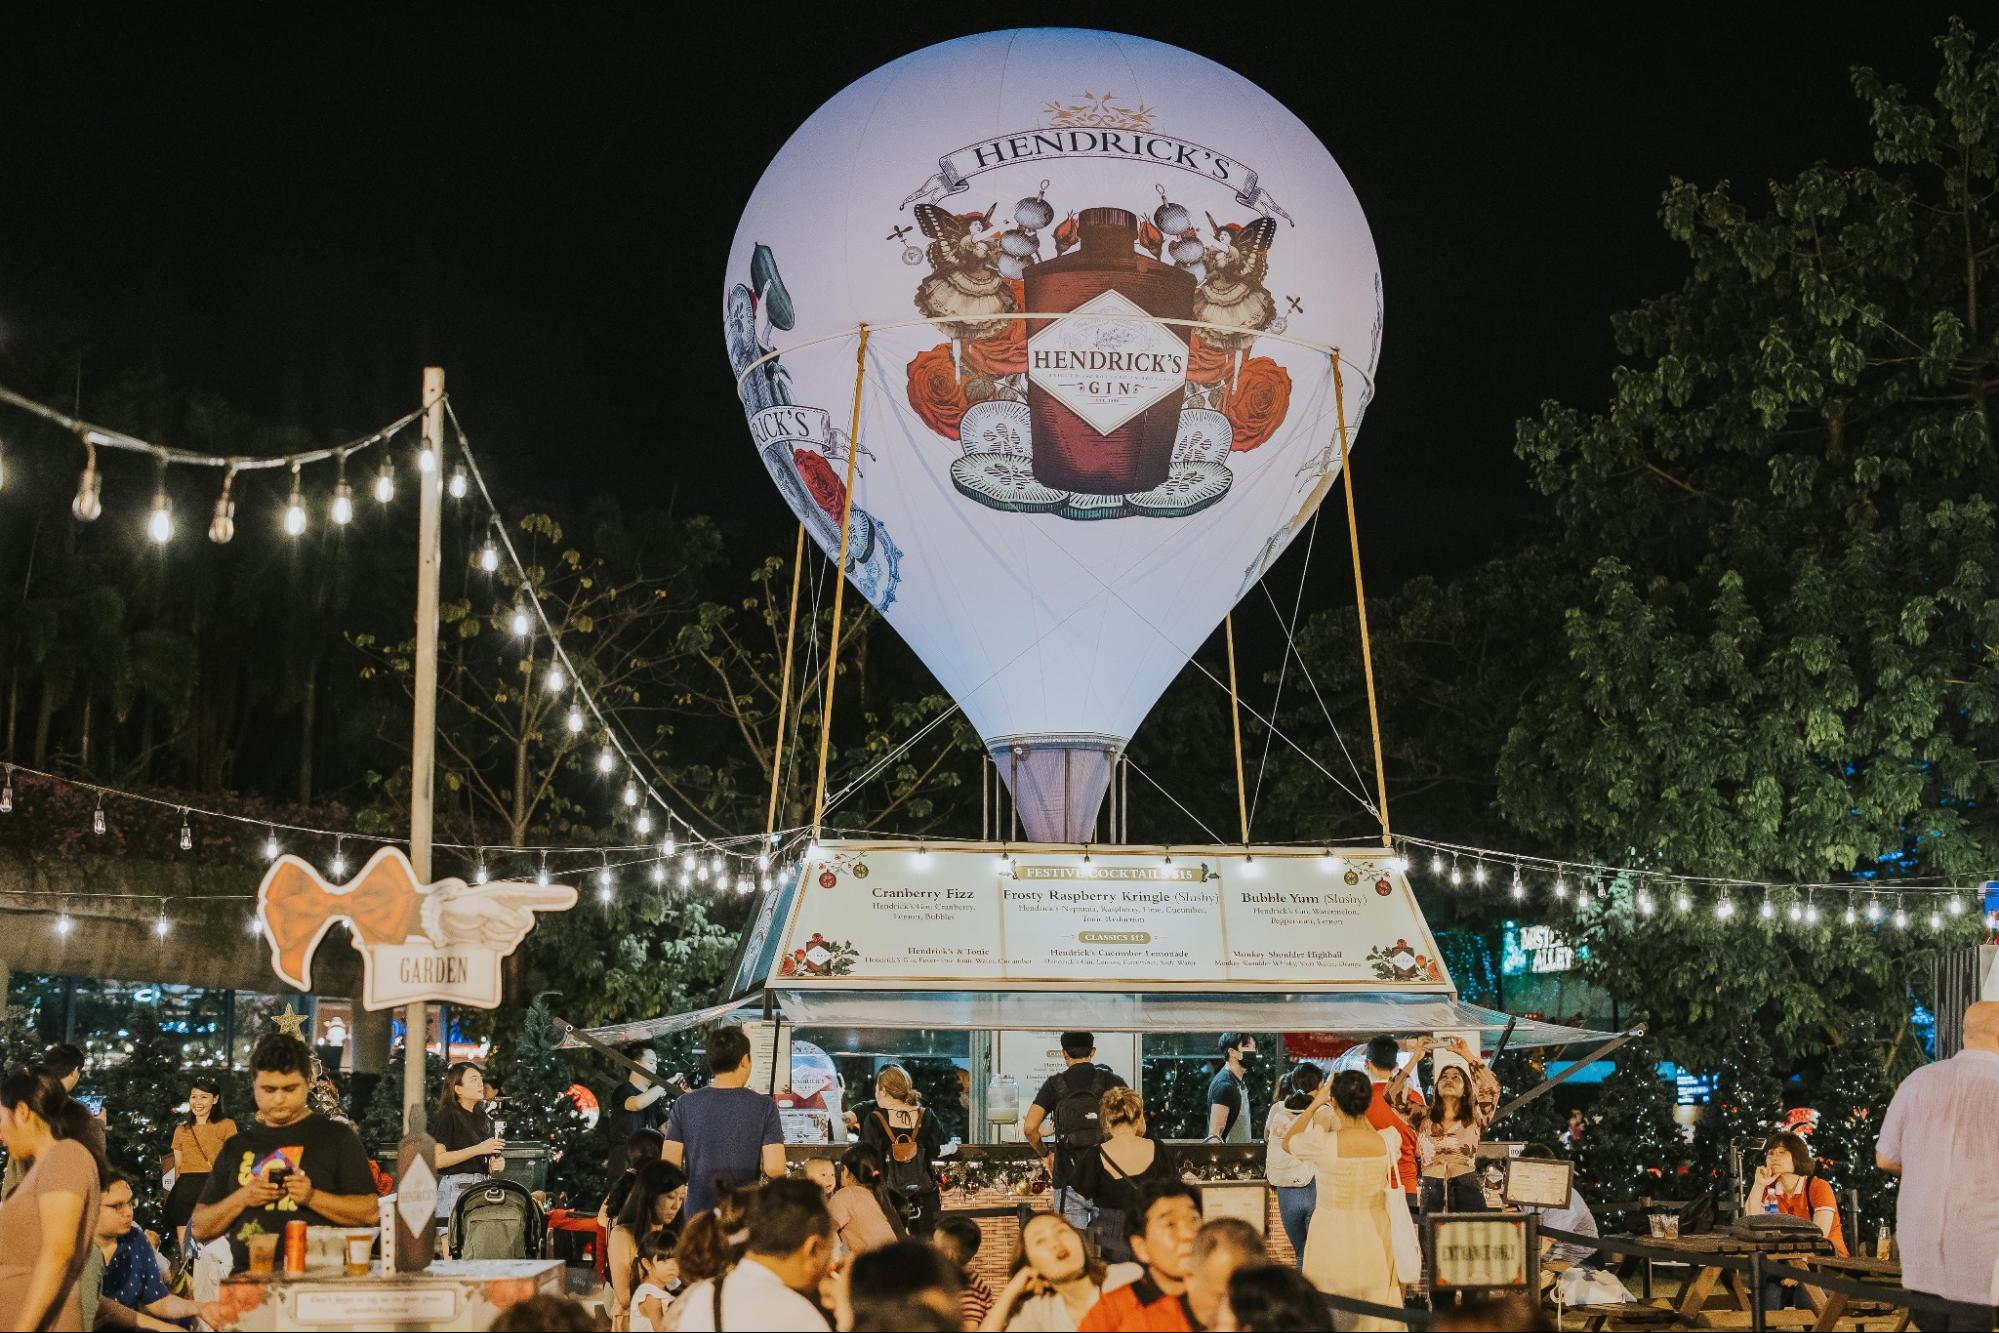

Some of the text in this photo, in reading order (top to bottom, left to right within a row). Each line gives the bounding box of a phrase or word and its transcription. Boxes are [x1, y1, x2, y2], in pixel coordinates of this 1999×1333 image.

[972, 131, 1230, 180] HENDRICK'S
[1034, 350, 1182, 374] HENDRICK'S
[1089, 381, 1130, 395] GIN
[1089, 868, 1164, 880] COCKTAIL
[872, 887, 975, 901] Cranberry Fizz
[1003, 889, 1043, 903] Frosty
[1049, 890, 1116, 904] Raspberry
[1121, 891, 1170, 905] Kringle
[1241, 892, 1287, 903] Bubble
[1289, 893, 1319, 904] Yum
[1085, 933, 1128, 941] CLASSICS
[1050, 949, 1188, 958] Hendrick's Cucumber Lemonade
[1233, 951, 1342, 960] Monkey Shoulder Highball
[400, 956, 468, 984] GARDEN
